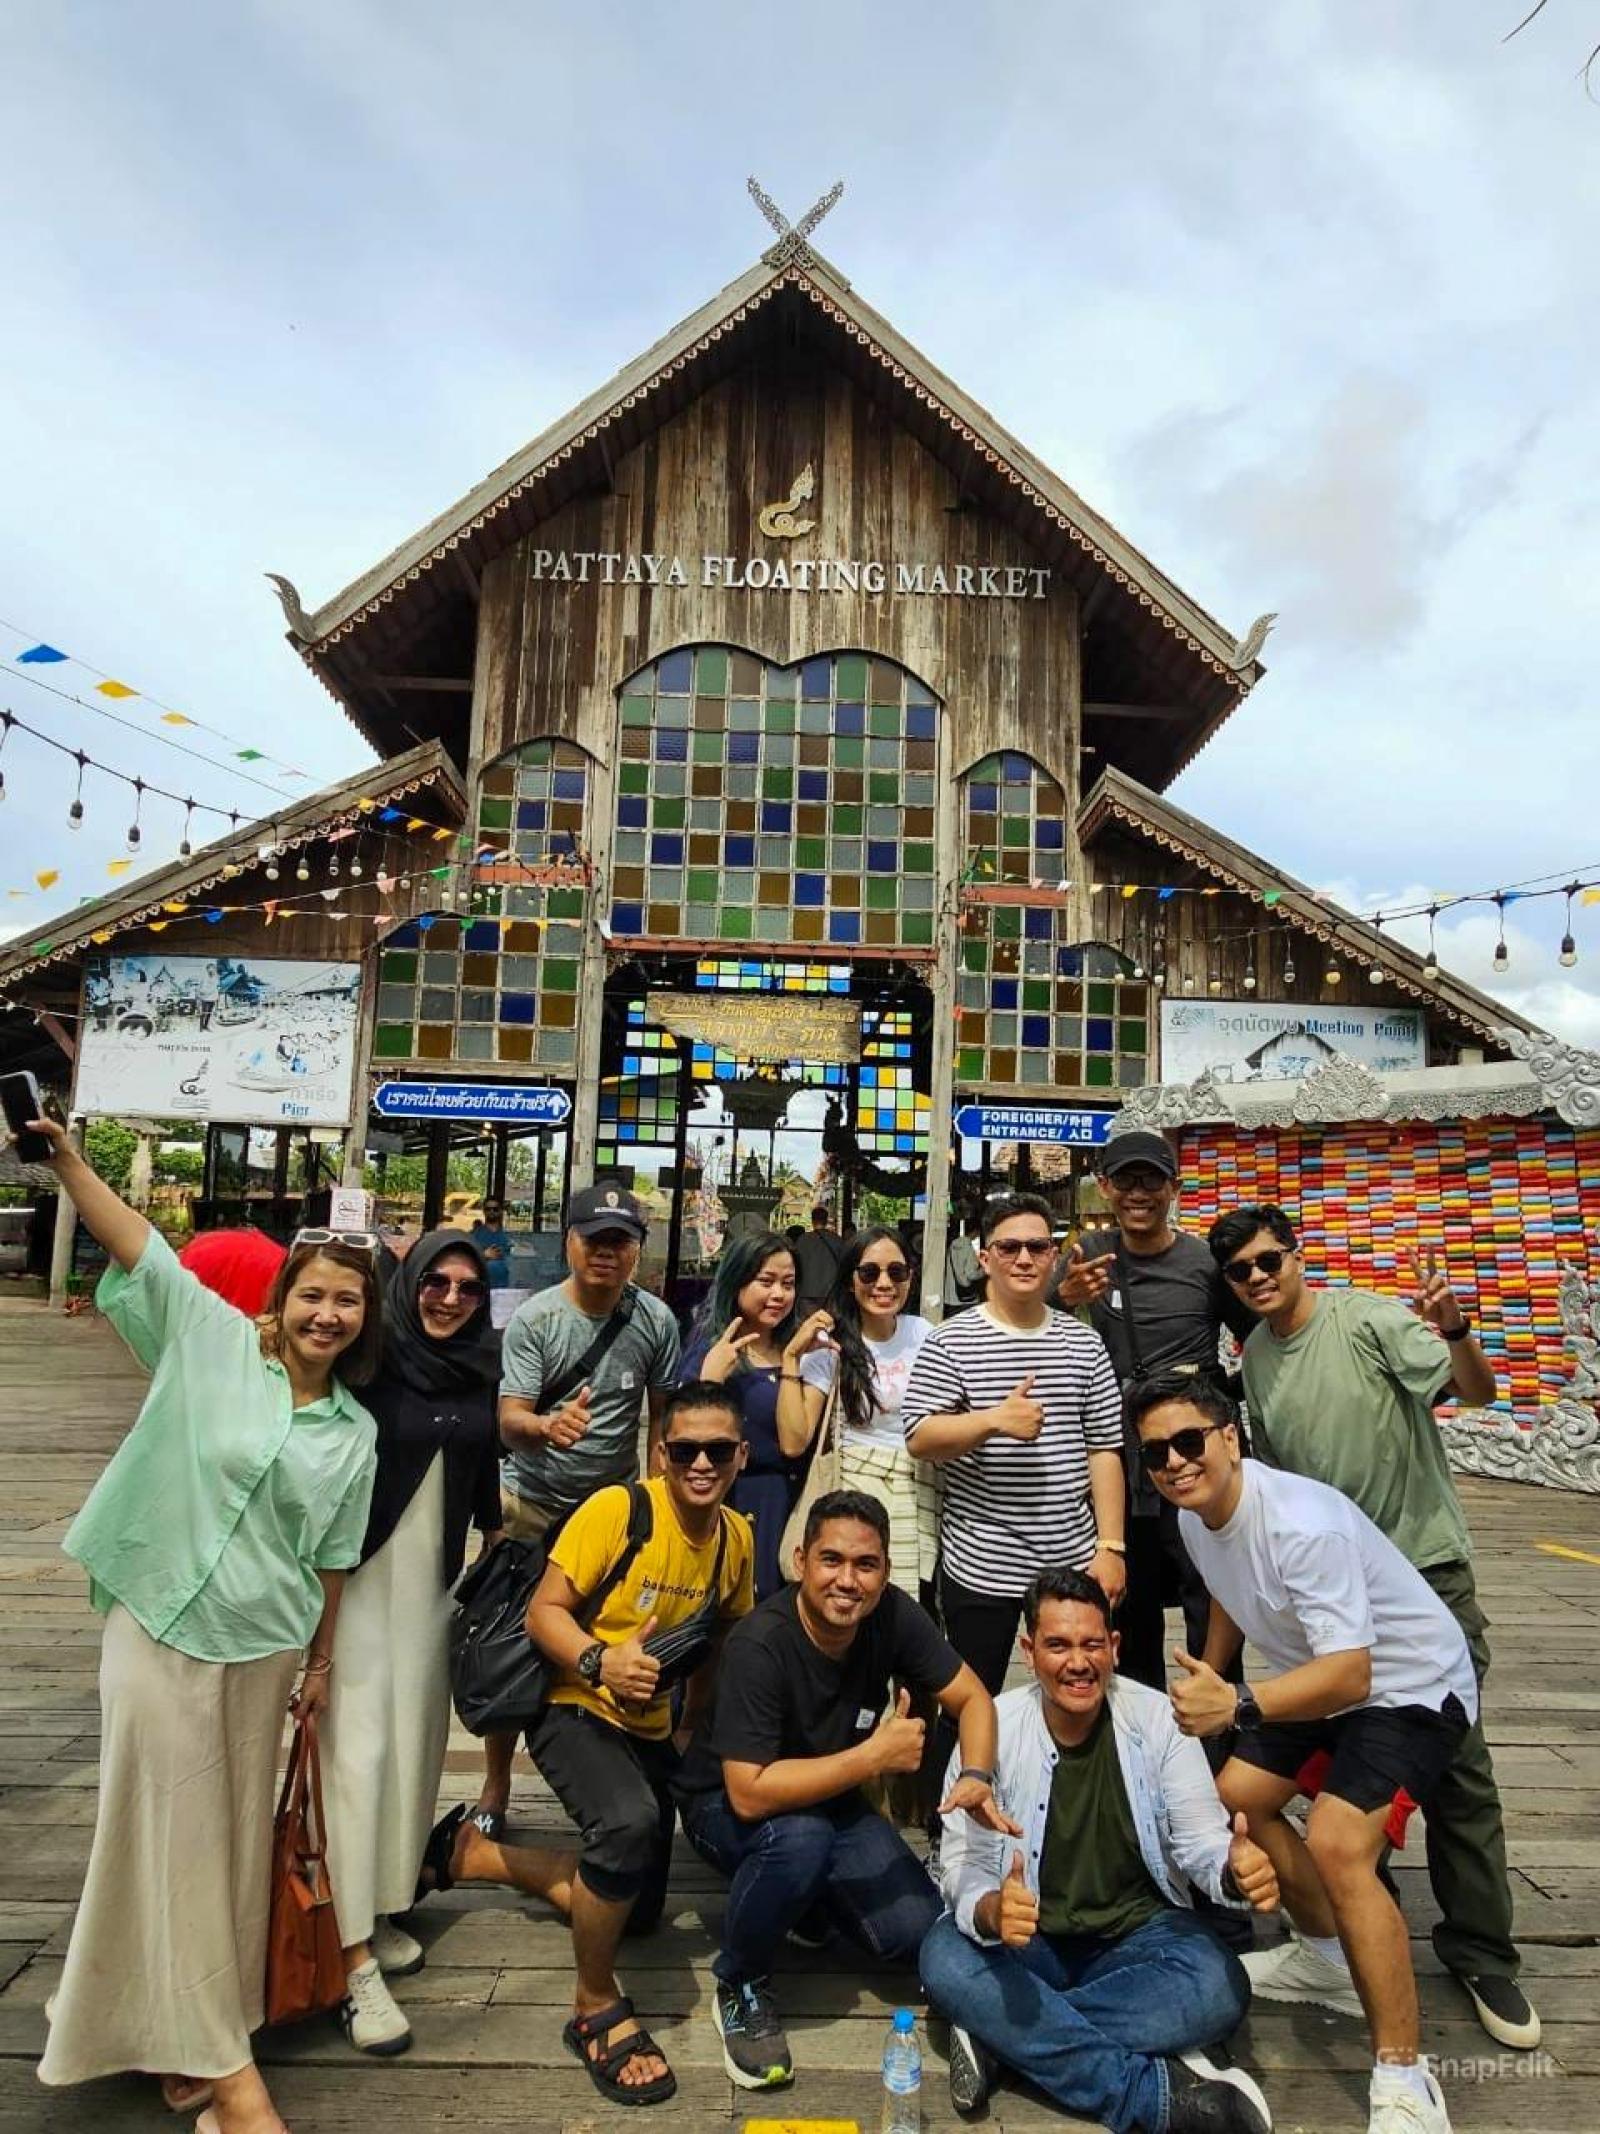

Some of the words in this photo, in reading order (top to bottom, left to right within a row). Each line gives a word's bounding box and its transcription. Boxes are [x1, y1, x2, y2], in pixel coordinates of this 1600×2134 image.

[532, 549, 688, 586] PATTAYA
[701, 556, 886, 593] FLOATING
[895, 563, 1051, 599] MARKET
[982, 1125, 1063, 1139] ENTRANCE/
